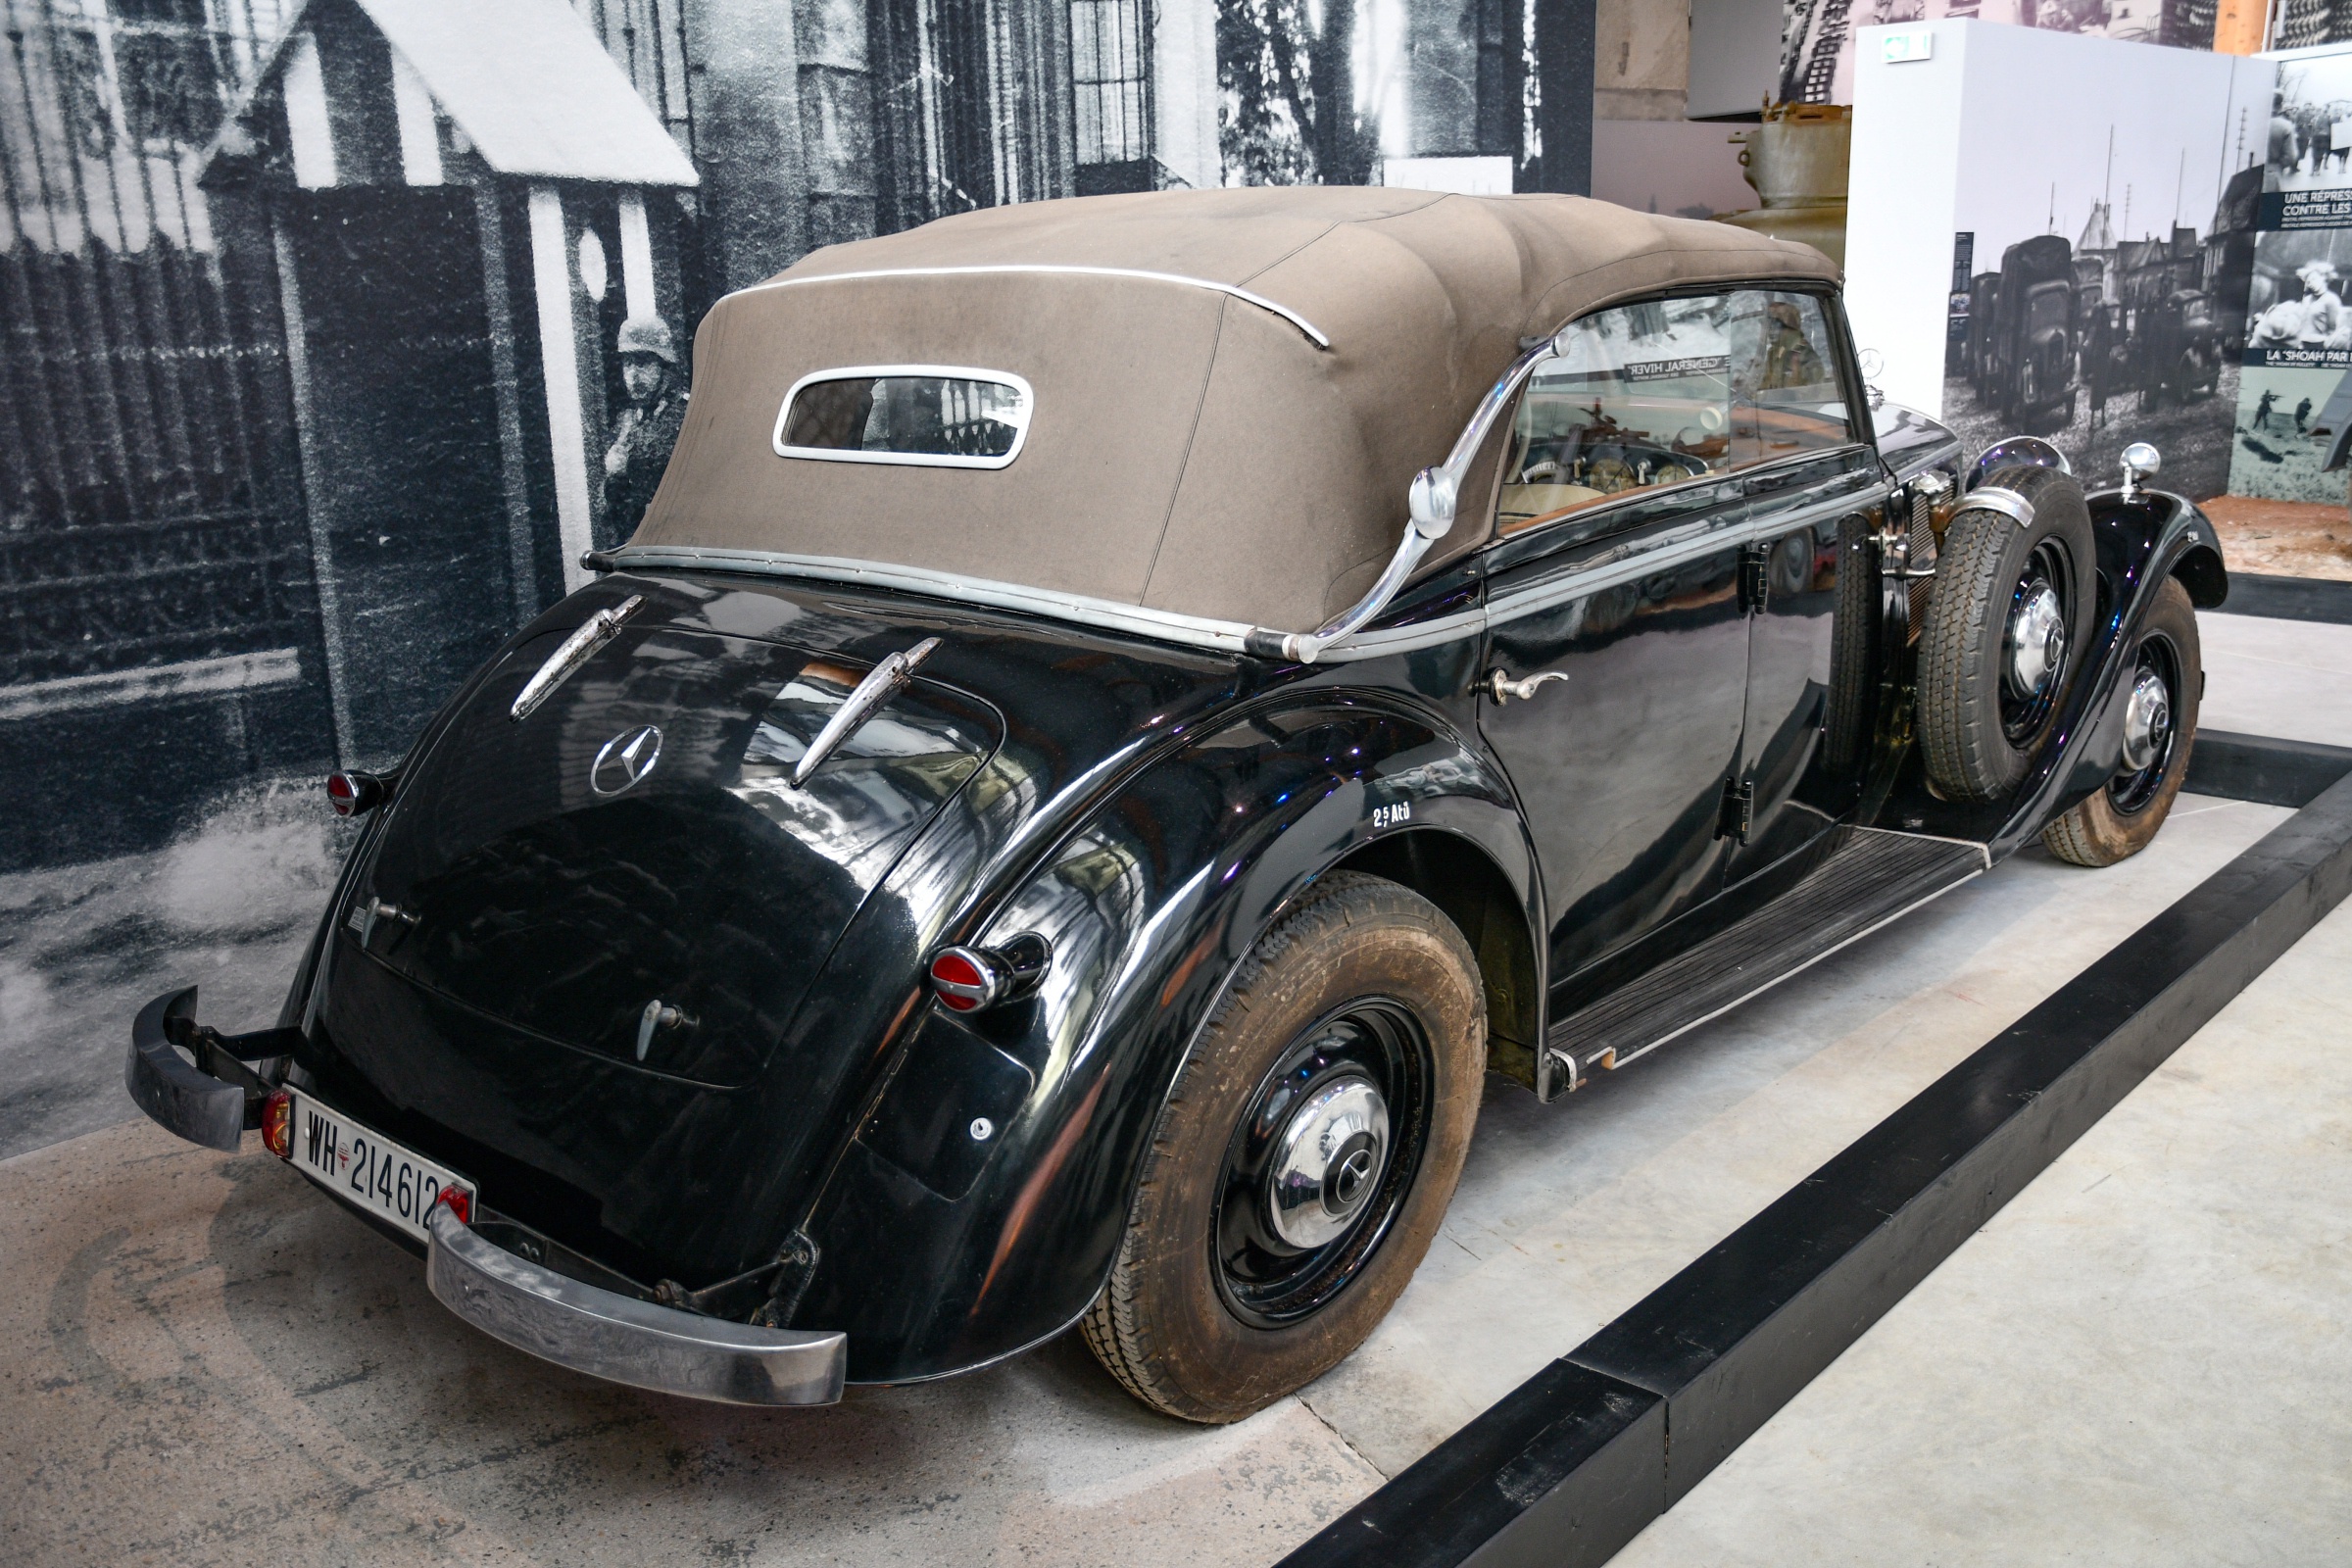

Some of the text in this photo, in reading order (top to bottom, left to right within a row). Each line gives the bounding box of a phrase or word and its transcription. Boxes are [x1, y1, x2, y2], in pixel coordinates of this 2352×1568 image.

[2284, 192, 2308, 204] UNE
[2282, 202, 2350, 216] CONTRE LES
[2266, 350, 2279, 361] LA
[2327, 351, 2347, 363] PAR
[1373, 807, 1390, 828] 2,5
[309, 1110, 440, 1231] WH 214612
